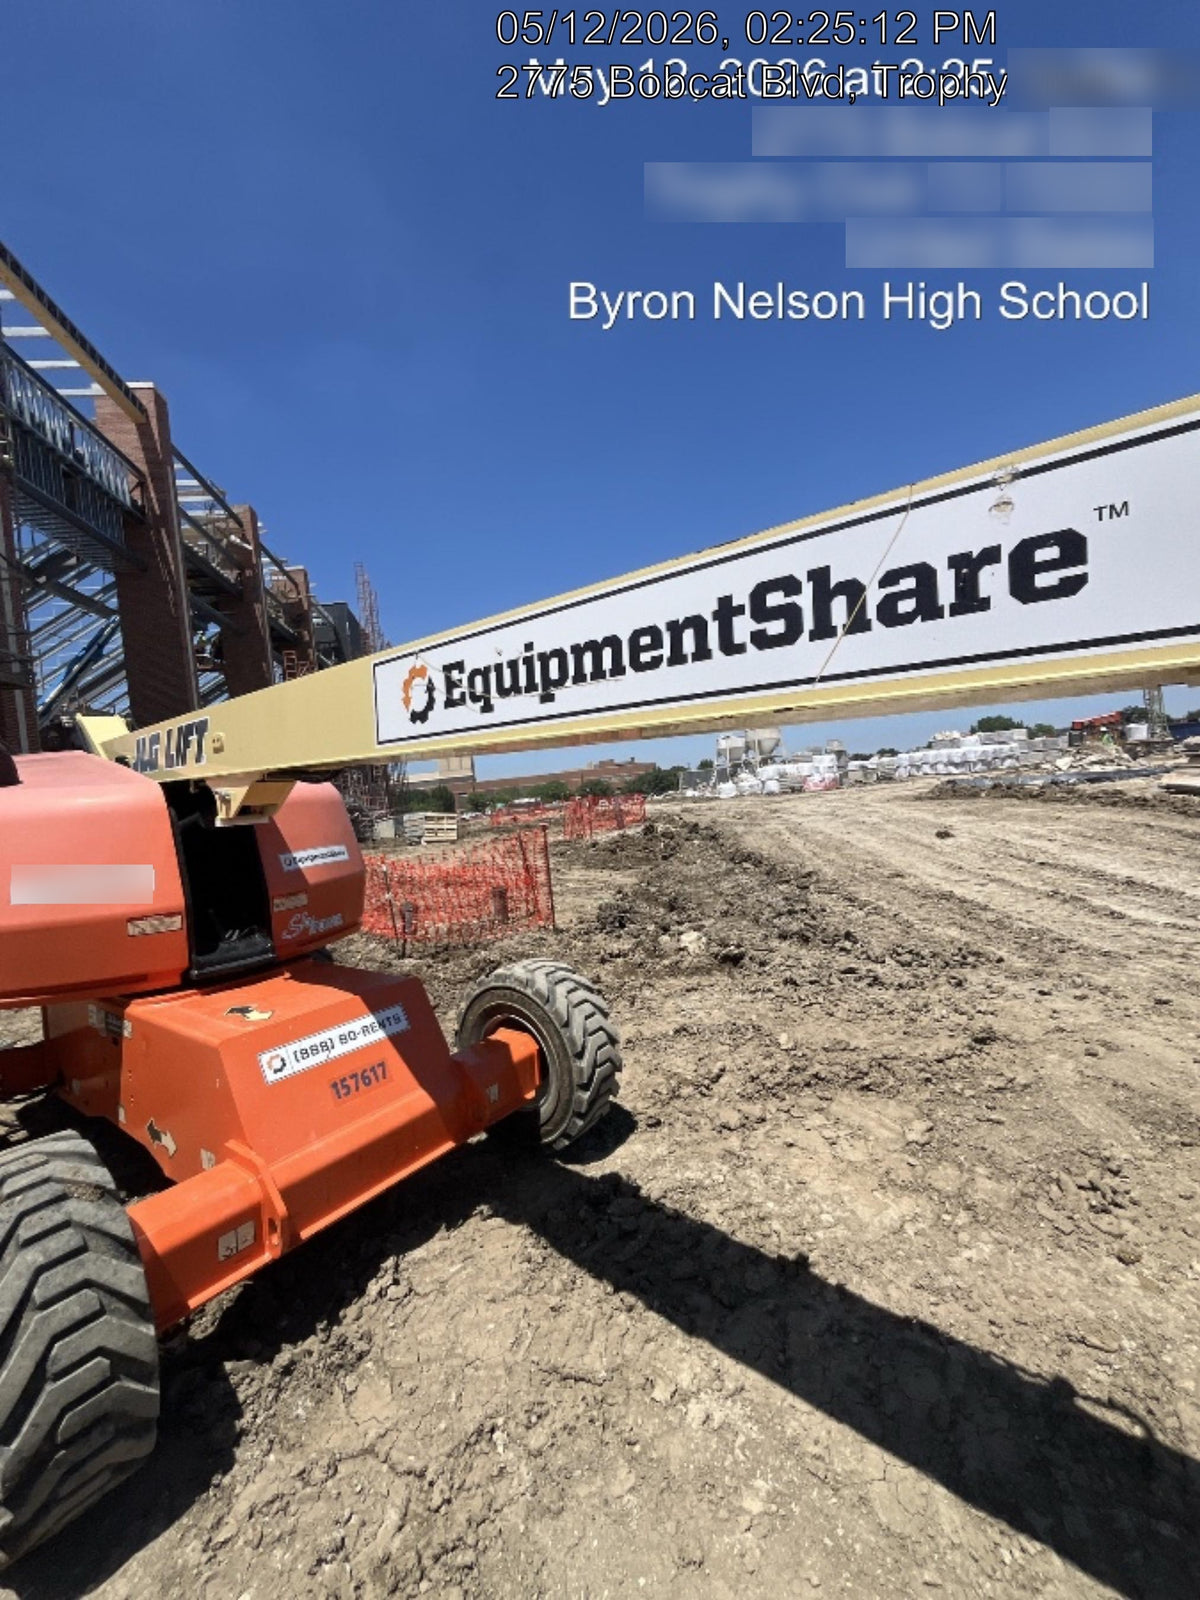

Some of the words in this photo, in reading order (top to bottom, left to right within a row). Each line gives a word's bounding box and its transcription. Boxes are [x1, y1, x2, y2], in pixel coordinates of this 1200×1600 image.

[442, 527, 1089, 714] EquipmentShare
[165, 716, 210, 770] LIFT
[293, 1037, 335, 1063] (888)
[331, 1060, 388, 1099] 157617
